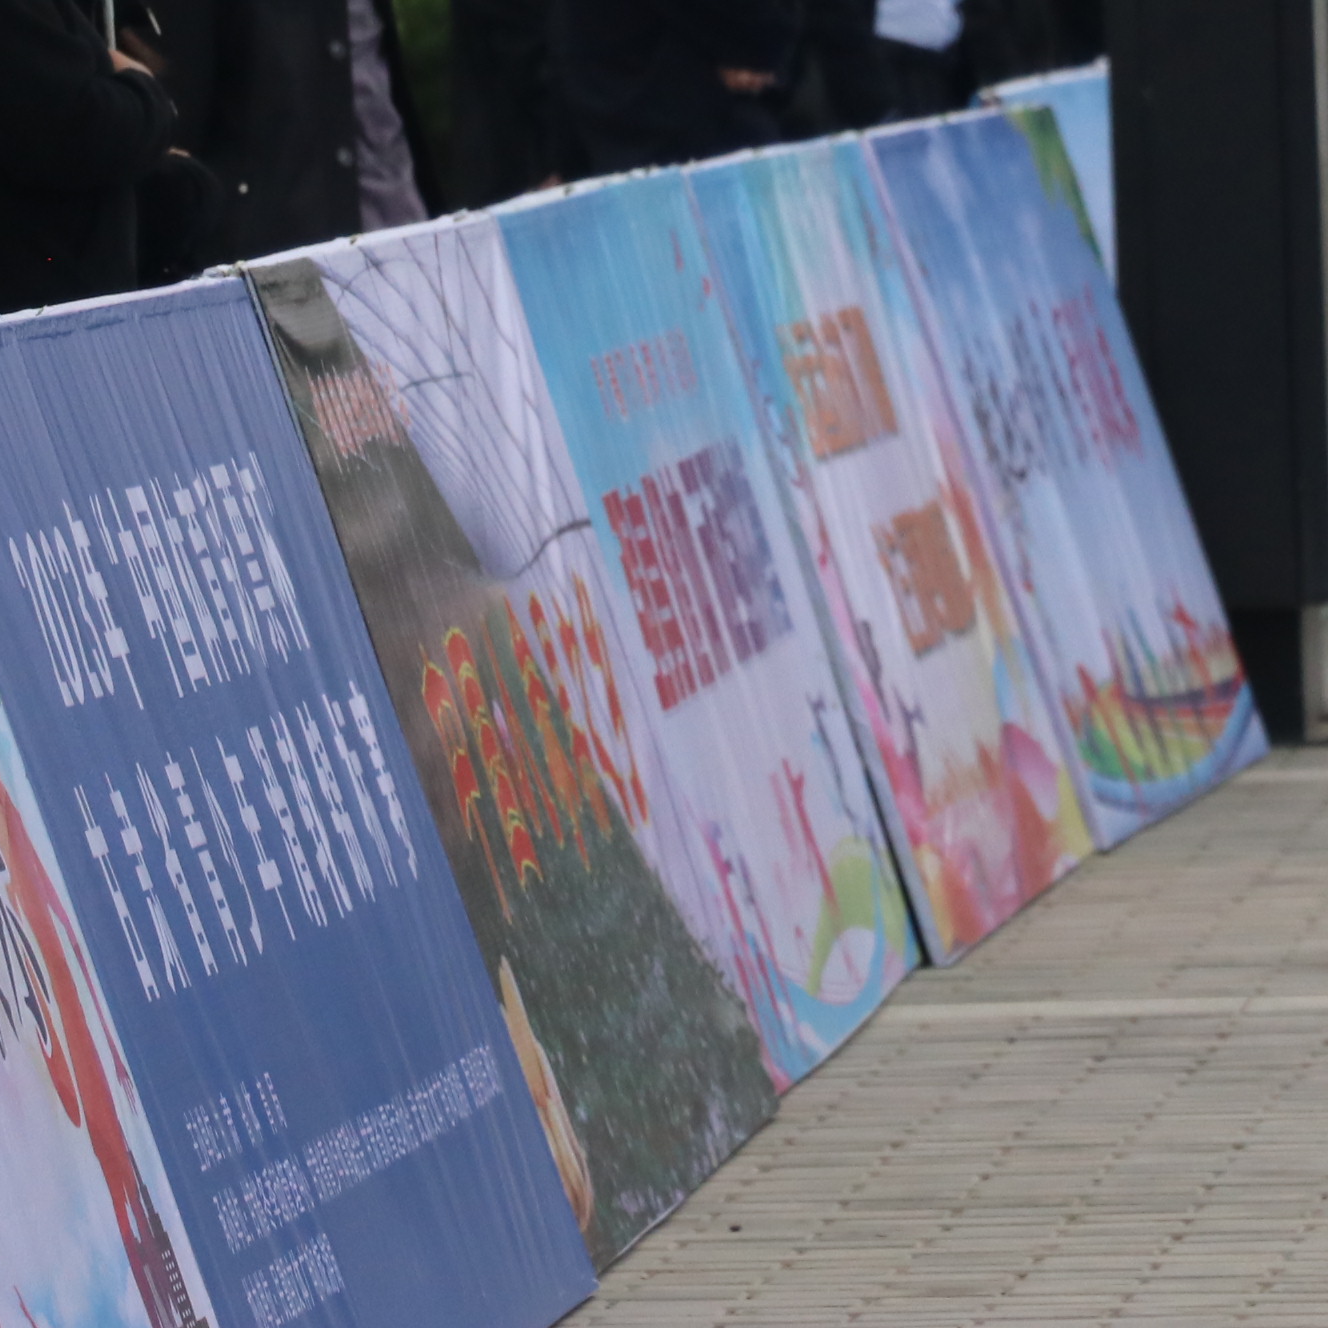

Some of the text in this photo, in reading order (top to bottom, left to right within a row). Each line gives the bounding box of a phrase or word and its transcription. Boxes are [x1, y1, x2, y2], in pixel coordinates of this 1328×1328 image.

[76, 682, 415, 997] 甘肃省青少年滑轮锦标赛
